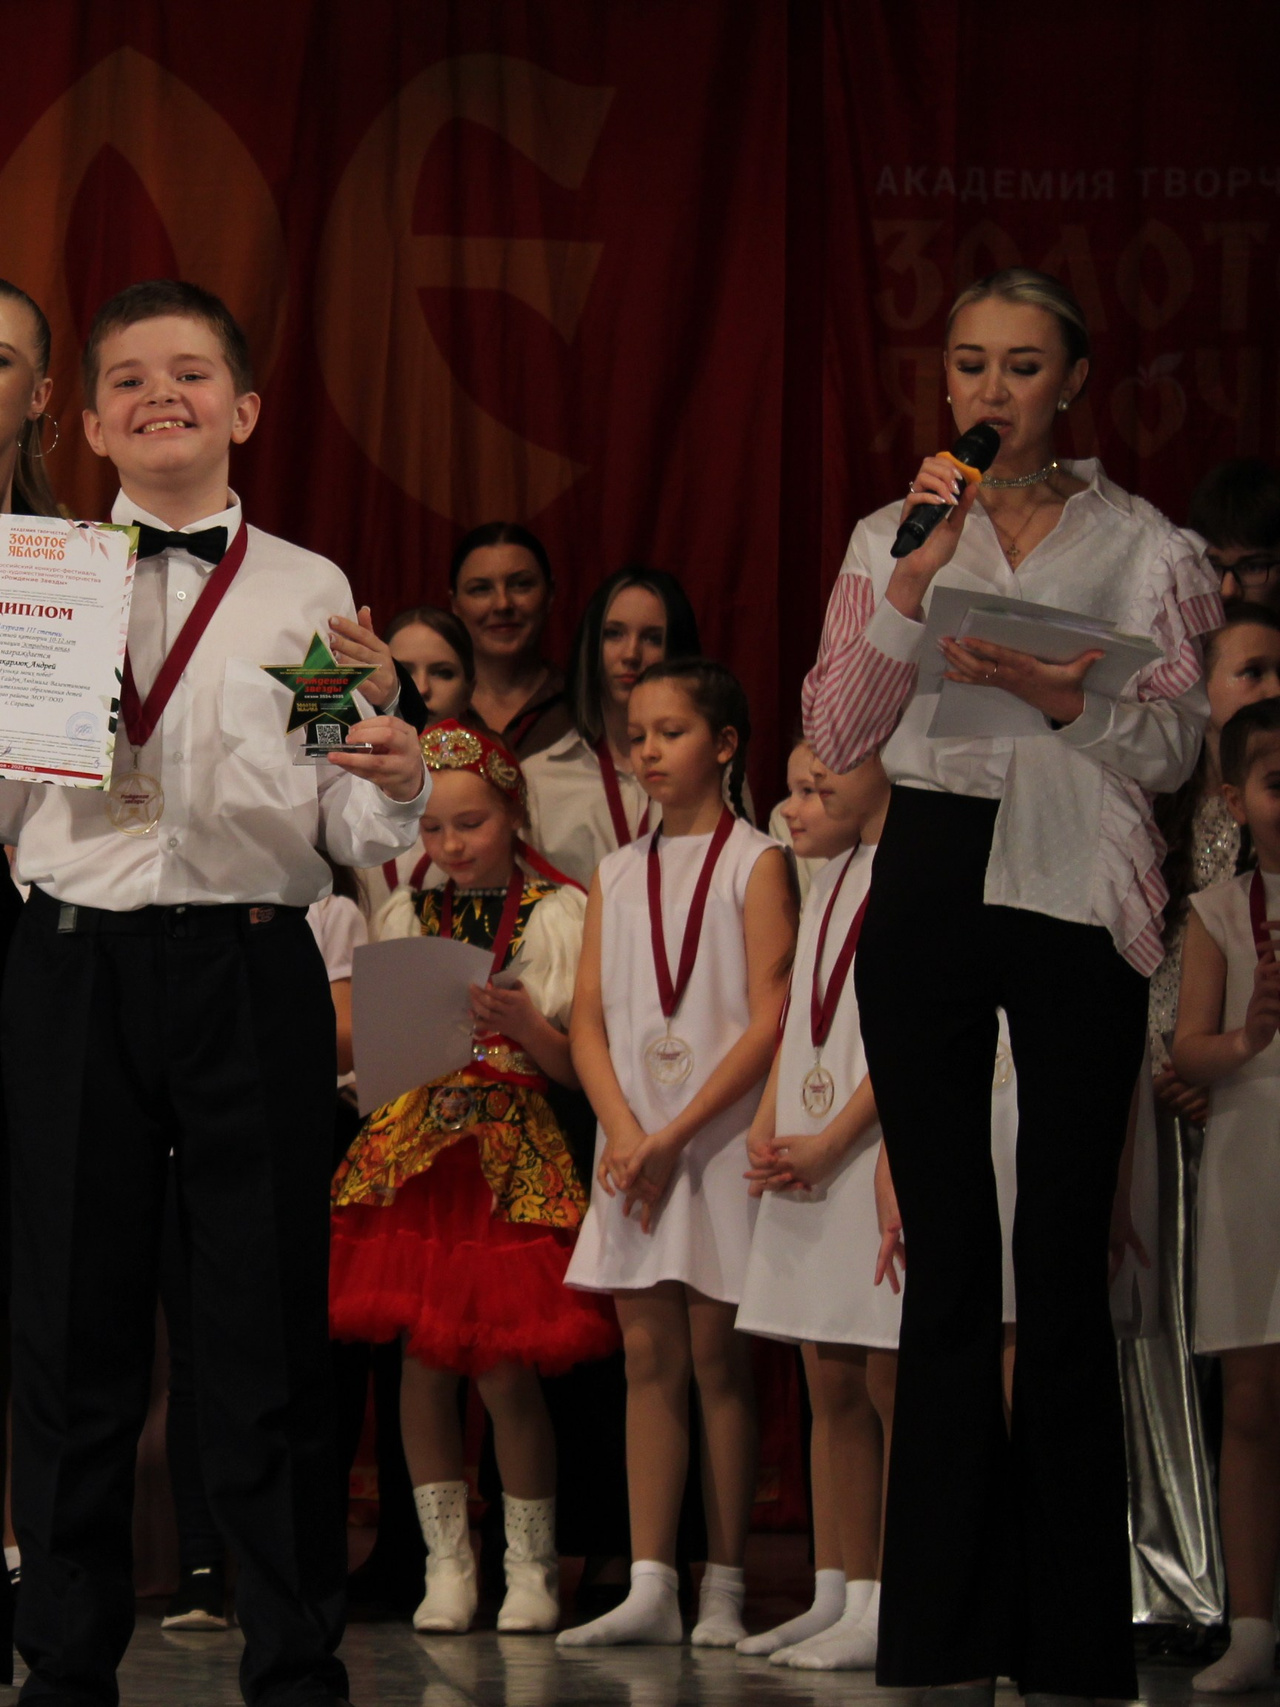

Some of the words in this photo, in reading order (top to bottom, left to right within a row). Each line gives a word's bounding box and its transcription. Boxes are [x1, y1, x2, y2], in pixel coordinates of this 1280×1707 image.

[875, 165, 1116, 203] АКАДЕМИЯ
[871, 217, 1280, 333] ЗОЛОТ
[9, 533, 67, 549] ЗОЛОТОЕ
[8, 545, 65, 561] ЯБЛОЧКО
[37, 629, 63, 637] степени
[0, 648, 51, 660] награждается
[30, 661, 57, 671] Андрей
